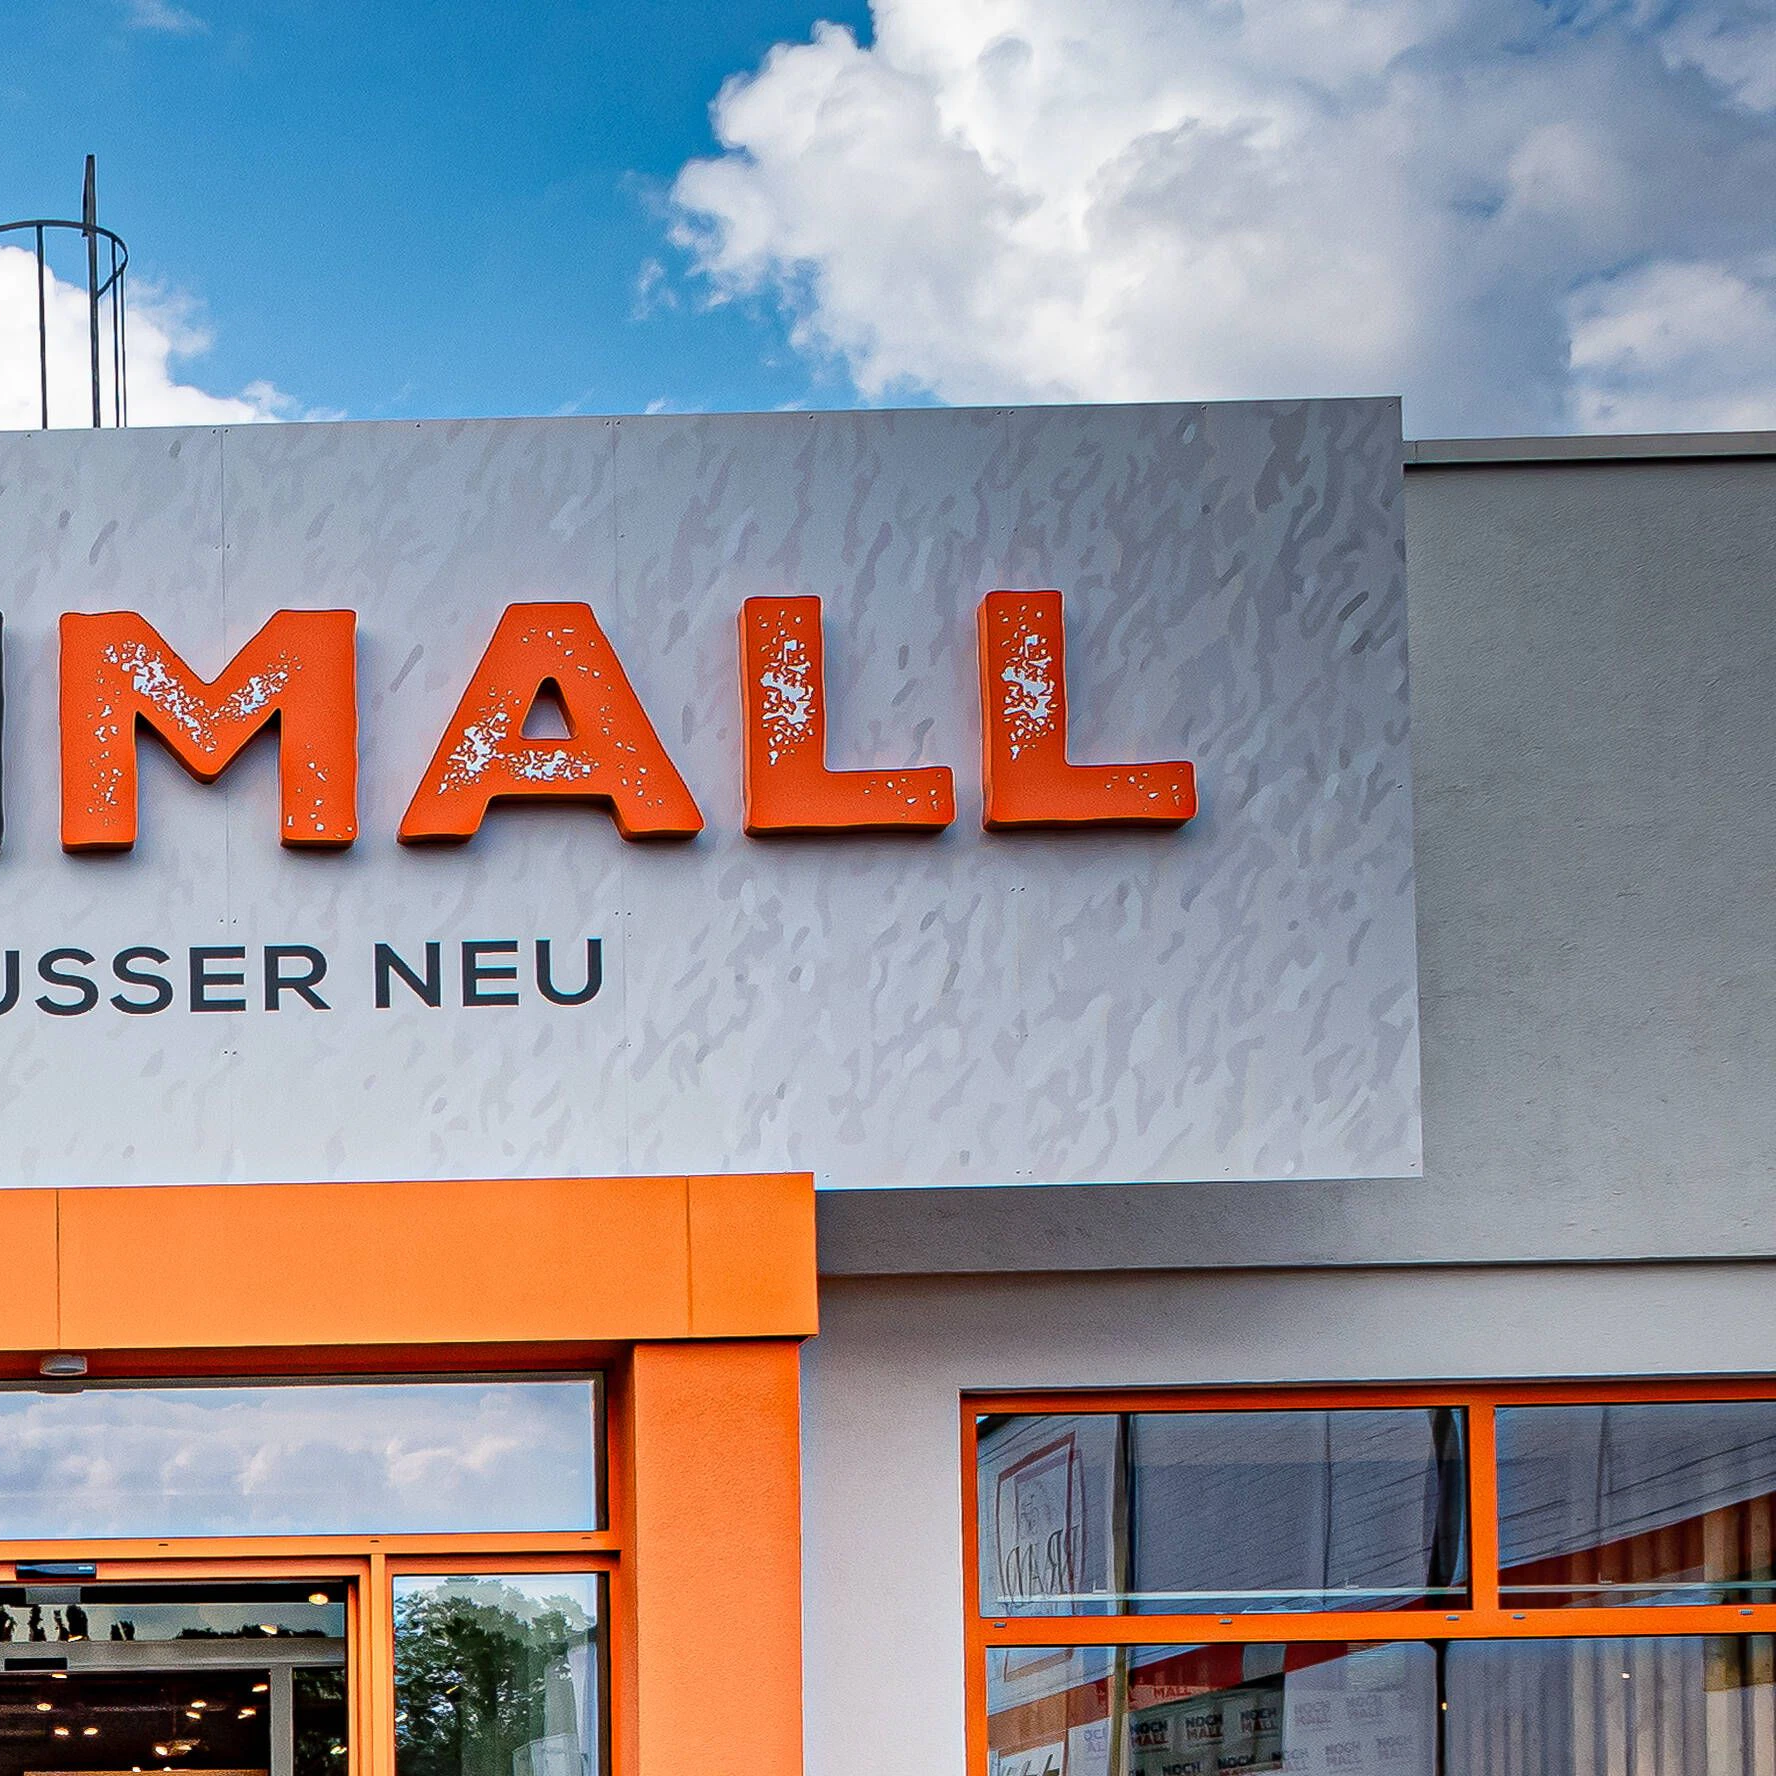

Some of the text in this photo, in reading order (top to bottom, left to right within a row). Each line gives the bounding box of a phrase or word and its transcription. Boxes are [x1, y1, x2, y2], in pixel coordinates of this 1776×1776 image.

[374, 938, 604, 1009] NEU
[1185, 1714, 1223, 1729] NOCH
[1240, 1707, 1278, 1722] NOCH
[1187, 1726, 1224, 1740] MALL
[1162, 1761, 1201, 1776] NOCH
[1218, 1754, 1255, 1769] NOCH
